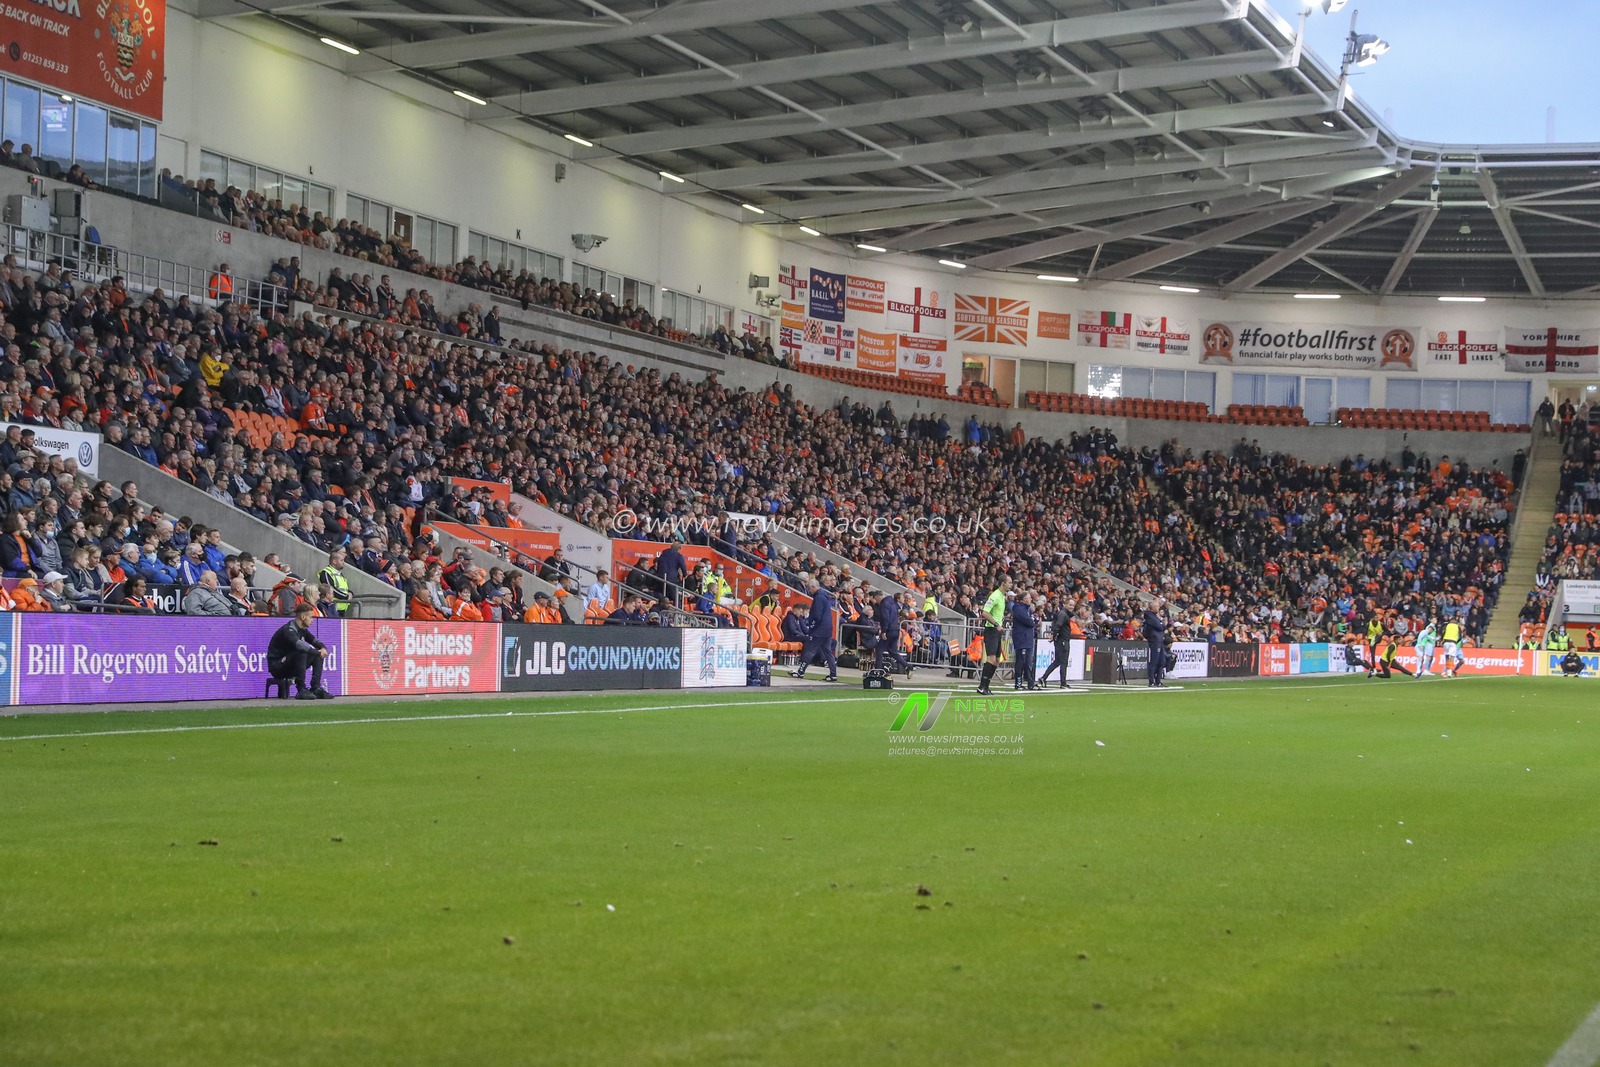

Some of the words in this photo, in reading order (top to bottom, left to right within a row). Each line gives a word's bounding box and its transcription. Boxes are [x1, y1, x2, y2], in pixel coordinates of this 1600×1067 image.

[5, 6, 29, 23] BACK
[30, 14, 42, 27] ON
[42, 18, 70, 37] TRACK
[22, 52, 42, 65] 01253
[43, 58, 55, 70] 858
[56, 62, 68, 74] 333
[97, 52, 133, 99] FOOTBALL
[135, 69, 153, 96] CLUB
[890, 302, 933, 316] BLACKPOOL
[957, 313, 976, 322] SOUTH
[976, 315, 995, 324] SHORE
[996, 316, 1026, 327] SEASIDERS
[1080, 325, 1118, 334] BLACKPOOL
[1137, 331, 1179, 339] BLACKPOOL
[1239, 328, 1376, 351] #footballfirst
[1239, 350, 1273, 359] financial
[1274, 351, 1288, 359] fair
[1290, 352, 1307, 361] play
[1308, 352, 1332, 360] works
[1335, 352, 1353, 361] both
[1355, 355, 1376, 363] ways
[34, 437, 69, 451] olkswagen
[1564, 604, 1570, 612] 3
[404, 626, 473, 655] Business
[27, 644, 65, 676] Bill
[72, 644, 168, 683] Rogerson
[174, 645, 232, 681] Safety
[525, 641, 566, 675] JLC
[568, 645, 680, 670] GROUNDWORKS
[1550, 655, 1599, 670] MM
[404, 660, 470, 688] Partners
